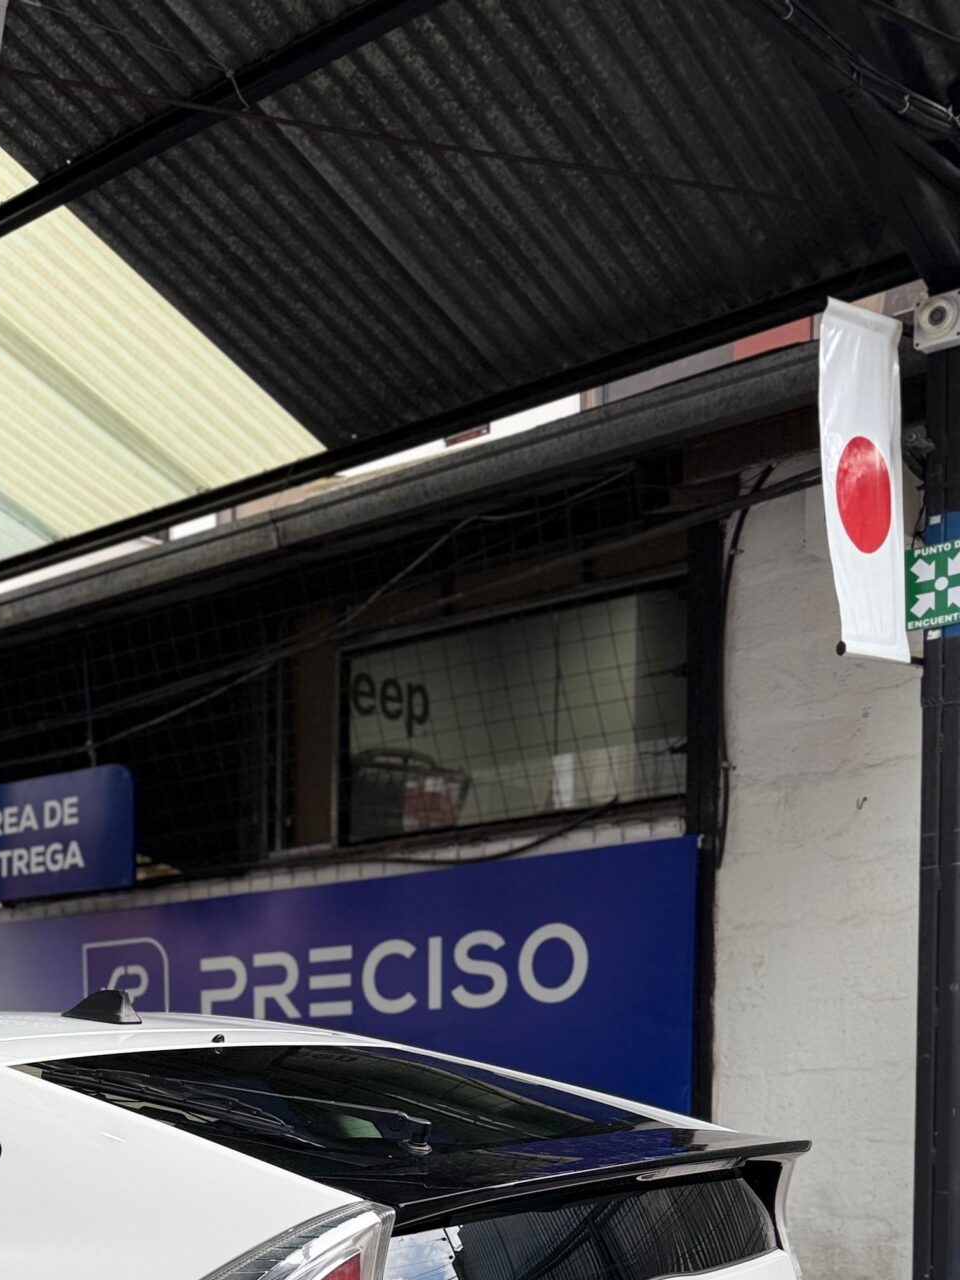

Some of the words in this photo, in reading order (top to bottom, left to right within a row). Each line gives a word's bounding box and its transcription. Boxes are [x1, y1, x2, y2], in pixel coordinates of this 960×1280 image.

[913, 542, 951, 557] PUNTO
[907, 612, 960, 629] ENCUENT
[43, 796, 79, 829] DE
[200, 923, 589, 1020] PRECISO
